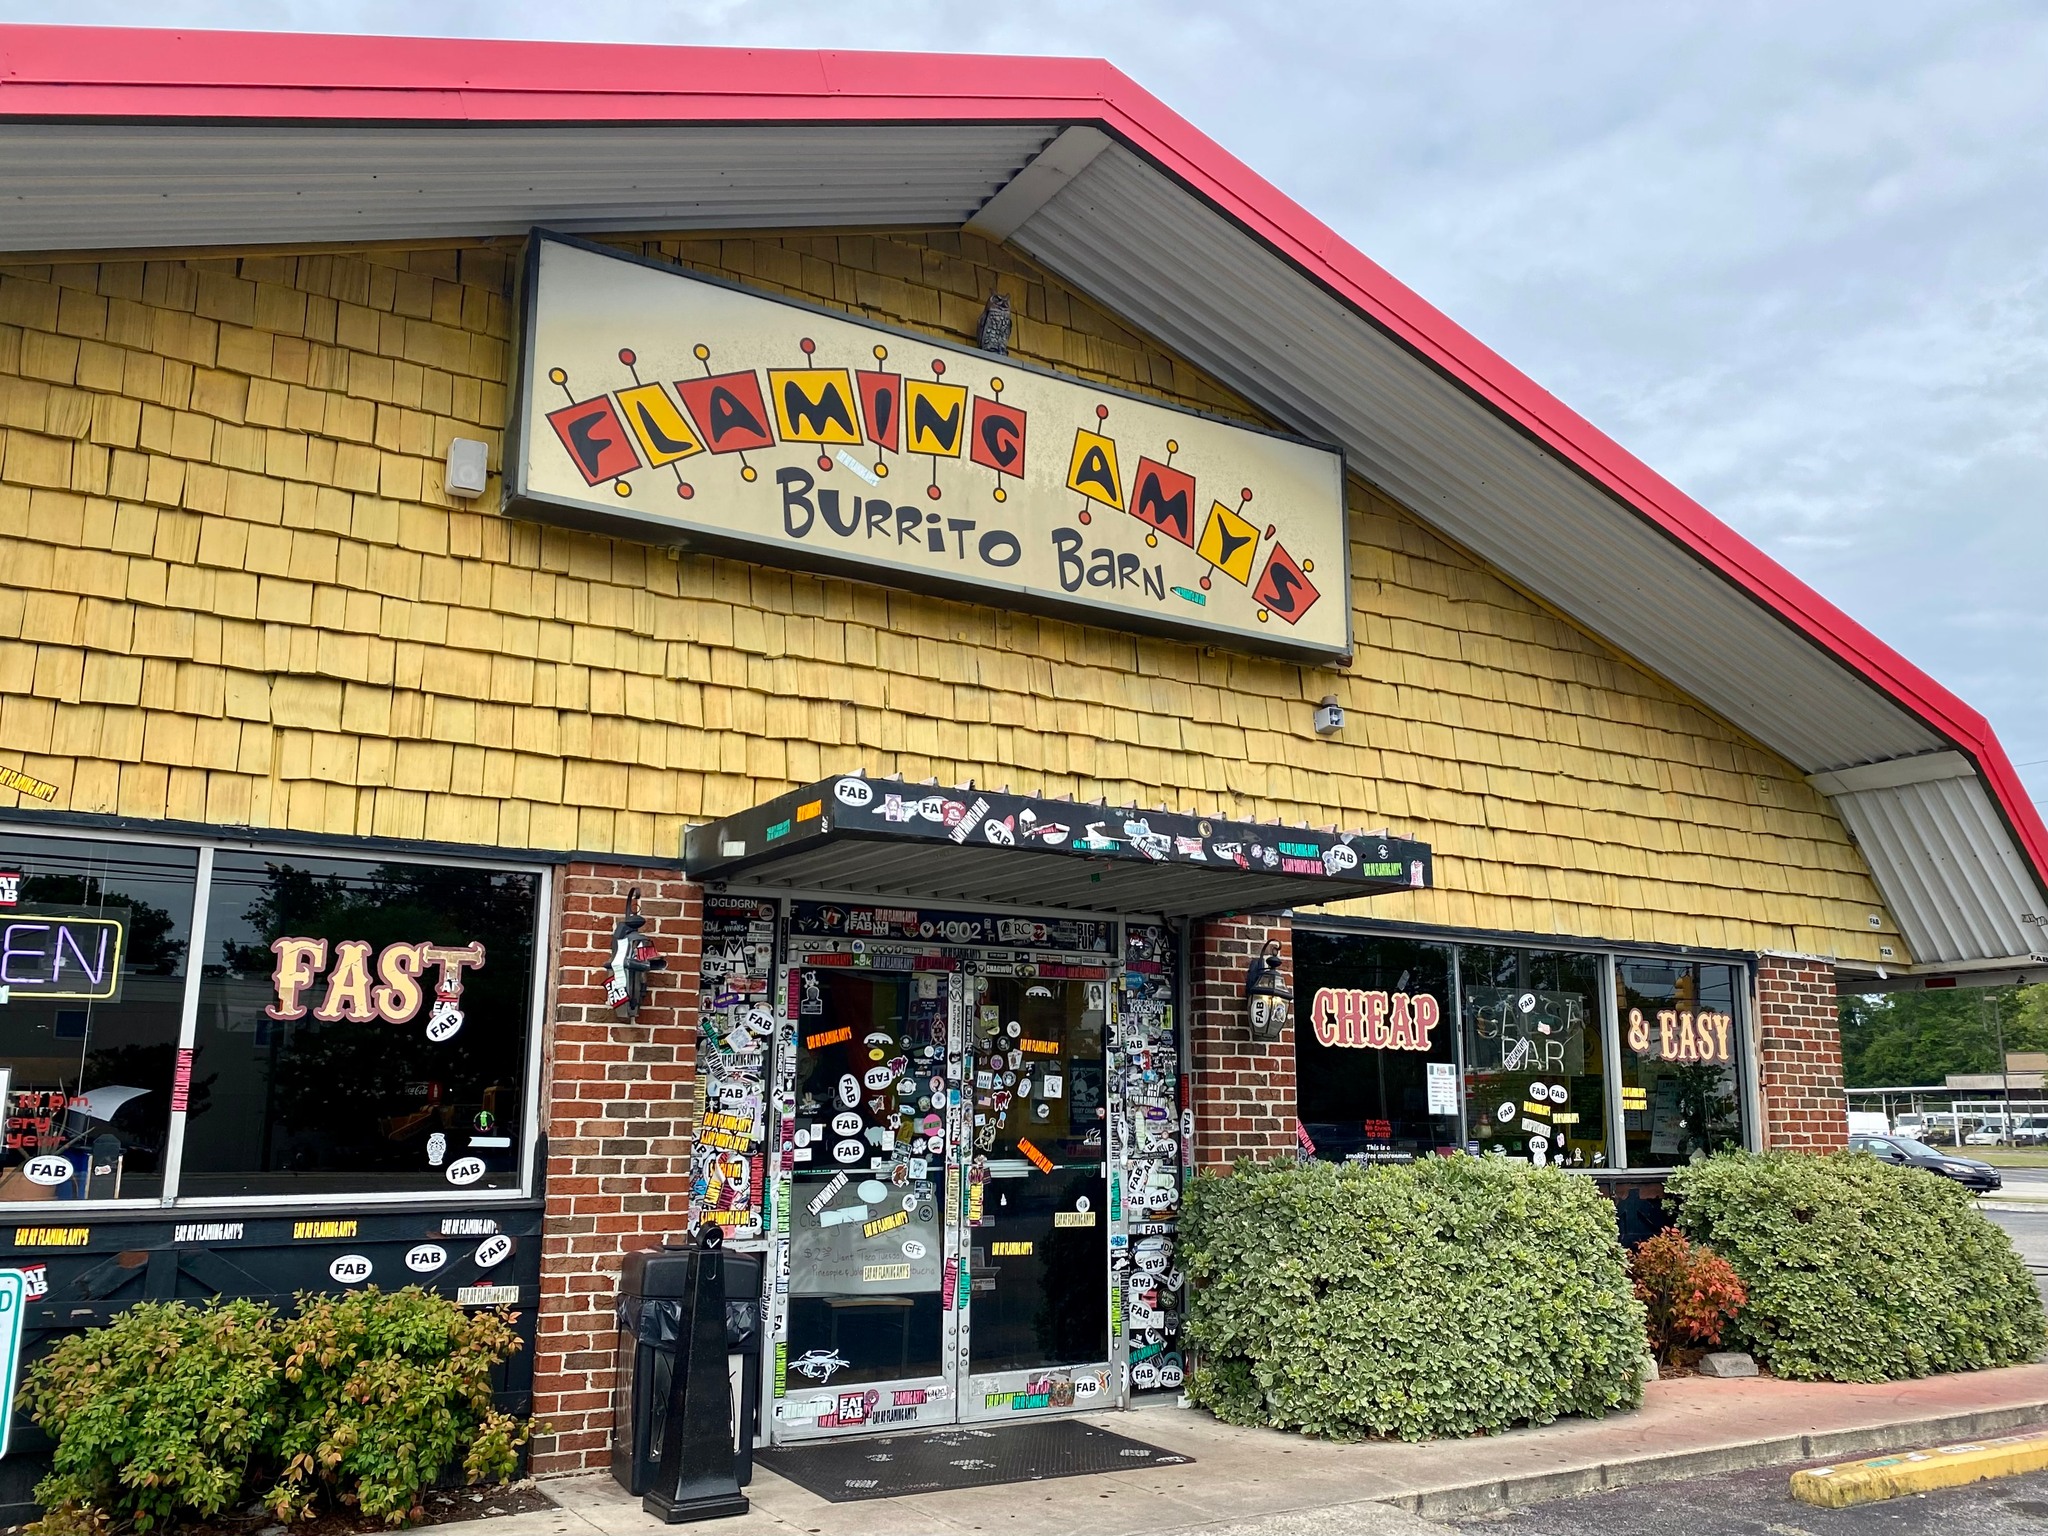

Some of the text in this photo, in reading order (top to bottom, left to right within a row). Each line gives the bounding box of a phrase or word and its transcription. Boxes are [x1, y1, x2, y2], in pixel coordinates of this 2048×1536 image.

[568, 380, 1303, 612] FLAMING AMY'S
[839, 784, 868, 800] FAB
[987, 823, 1011, 845] FAB
[1334, 850, 1354, 864] FAB
[0, 878, 19, 890] AT
[0, 890, 17, 902] AB
[851, 911, 872, 922] EAT
[850, 921, 872, 931] FAB
[934, 920, 982, 939] 4002
[1014, 923, 1031, 935] RC
[1077, 922, 1094, 938] BIG
[1077, 938, 1094, 950] FUN
[0, 924, 109, 985] EN
[2031, 955, 2048, 963] FAB
[703, 961, 727, 972] FAB
[265, 937, 485, 1024] FAST
[608, 987, 627, 1005] FAB
[1520, 997, 1534, 1010] FAB
[749, 1013, 772, 1031] FAB
[1311, 987, 1439, 1051] CHEAP
[430, 1014, 458, 1038] FAB
[1628, 1007, 1732, 1063] & EASY
[868, 1072, 890, 1084] FAB
[720, 1088, 743, 1099] FAB
[843, 1077, 856, 1104] FAB
[1532, 1087, 1546, 1096] FAB
[1551, 1089, 1566, 1099] FAB
[1500, 1106, 1513, 1119] FAB
[7, 1117, 50, 1132] ery
[836, 1120, 858, 1130] FAB
[1531, 1140, 1546, 1149] FAB
[838, 1146, 860, 1157] FAB
[30, 1164, 67, 1177] FAB
[451, 1163, 480, 1180] FAB
[1130, 1167, 1142, 1190] FAB
[1150, 1193, 1168, 1205] FAB
[876, 1215, 896, 1233] FLAMING
[894, 1211, 908, 1227] AMY'S
[1067, 1213, 1084, 1225] FLAMING
[1083, 1213, 1095, 1224] AMY'S
[174, 1224, 243, 1241] EAT AT FLAMING AMY'S
[294, 1221, 357, 1238] EAT AT FLAMING AMY'S
[1145, 1225, 1163, 1234] FAB
[15, 1228, 89, 1245] EAT AT FLAMING AMY'S
[411, 1252, 441, 1265] FAB
[479, 1240, 507, 1264] FAB
[335, 1263, 366, 1275] FAB
[1146, 1258, 1164, 1269] FAB
[26, 1268, 46, 1282] AT
[864, 1266, 872, 1279] EAT
[872, 1266, 878, 1279] AT
[878, 1265, 896, 1278] FLAMING
[896, 1264, 909, 1278] AMY'S
[26, 1282, 49, 1296] AB
[1132, 1279, 1150, 1288] FAB
[1131, 1305, 1150, 1319] FAB
[1135, 1369, 1153, 1379] FAB
[1161, 1372, 1180, 1381] FAB
[1077, 1382, 1096, 1392] FAB
[840, 1397, 863, 1408] EAT
[840, 1408, 863, 1419] FAB
[886, 1409, 904, 1423] FLAMING
[904, 1407, 917, 1421] AMY'S
